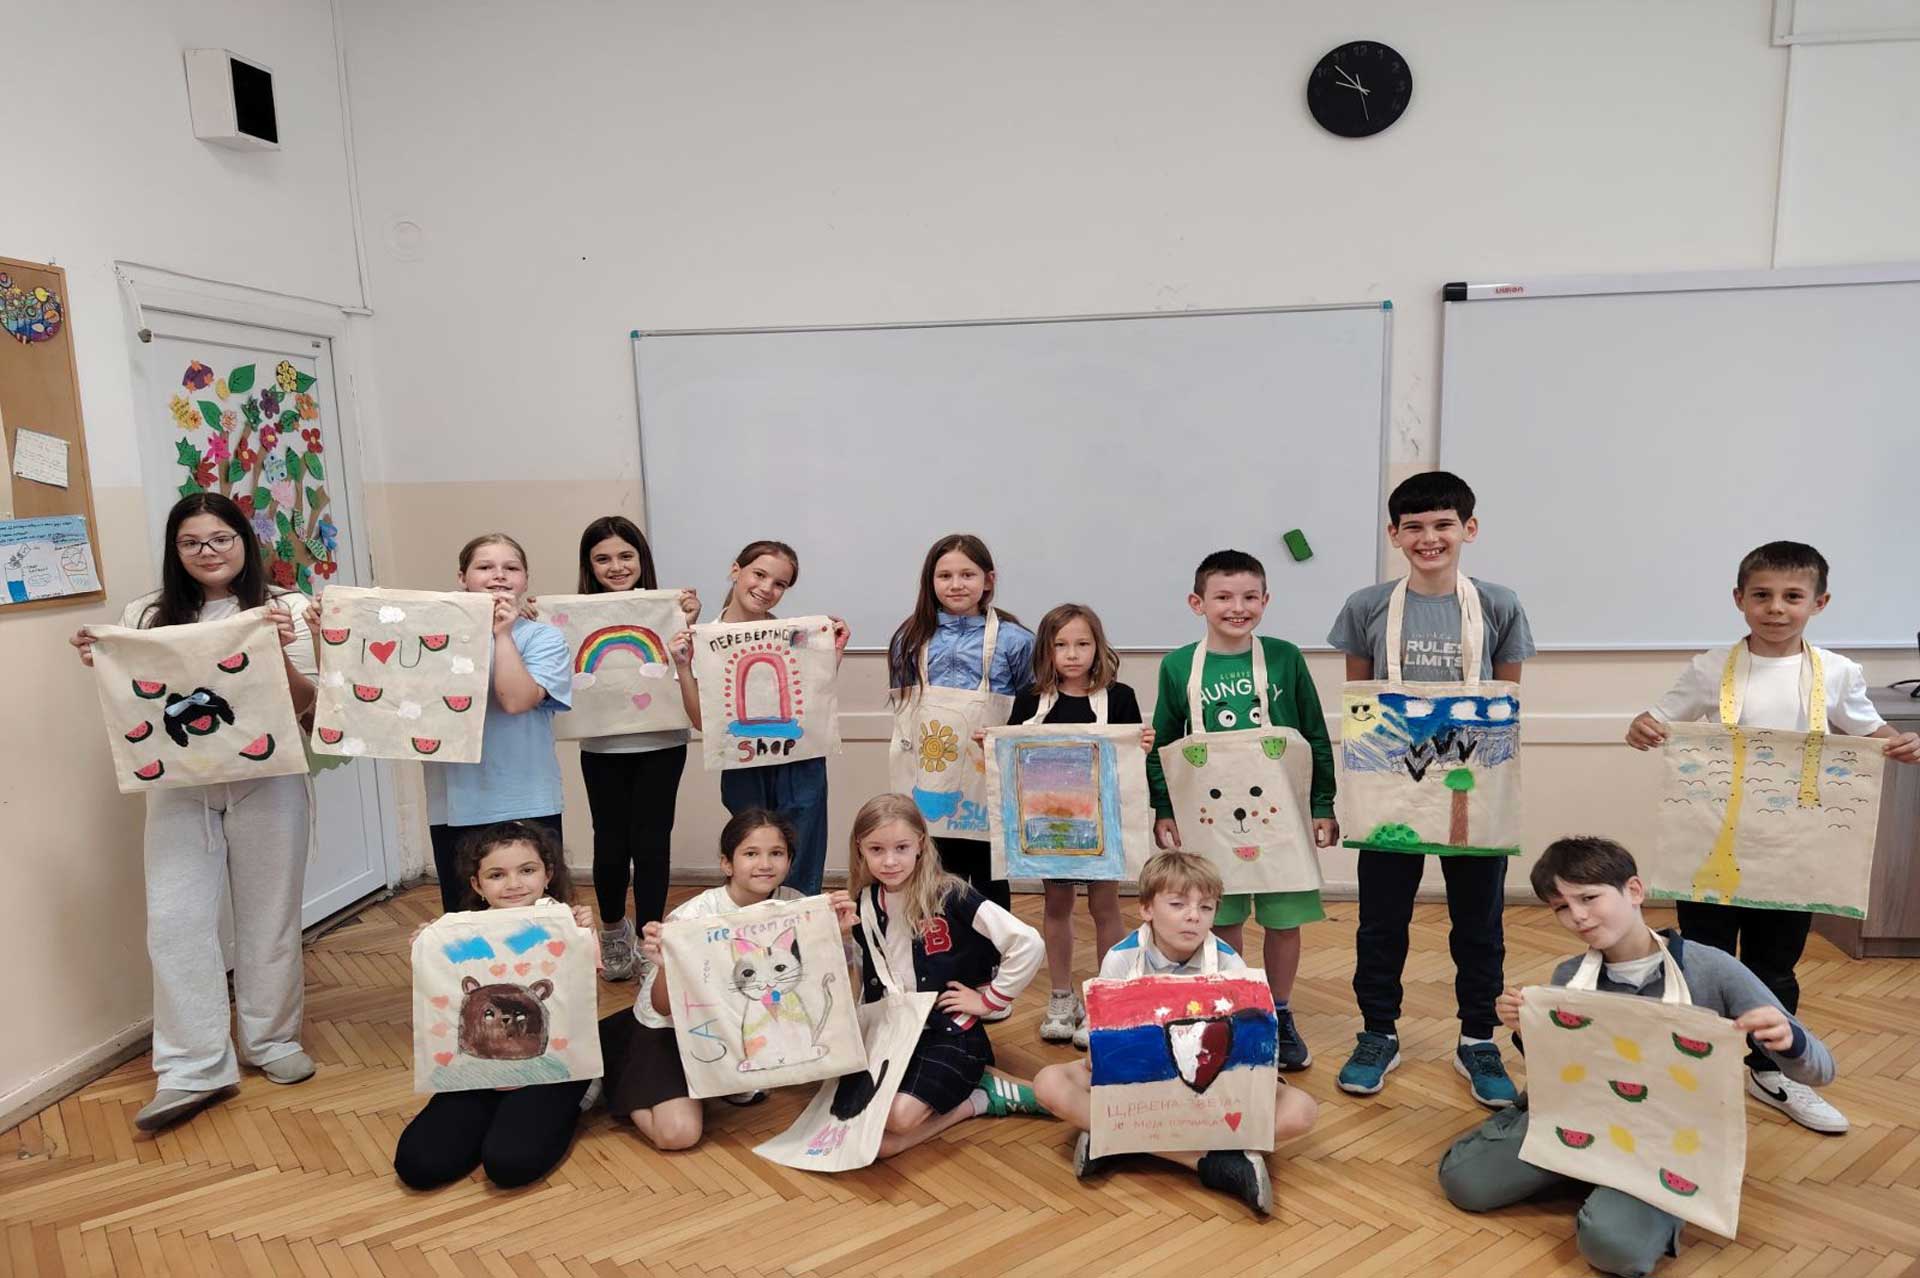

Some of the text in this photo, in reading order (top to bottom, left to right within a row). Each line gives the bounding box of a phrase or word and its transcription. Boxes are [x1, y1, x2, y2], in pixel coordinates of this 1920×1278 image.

[361, 638, 422, 668] I U
[1404, 654, 1463, 667] LIMITS
[1220, 671, 1251, 680] ALWAYS
[1200, 678, 1283, 705] UNGY
[707, 927, 731, 944] ice
[735, 920, 778, 939] cream
[919, 916, 953, 956] B
[684, 991, 727, 1063] CAT
